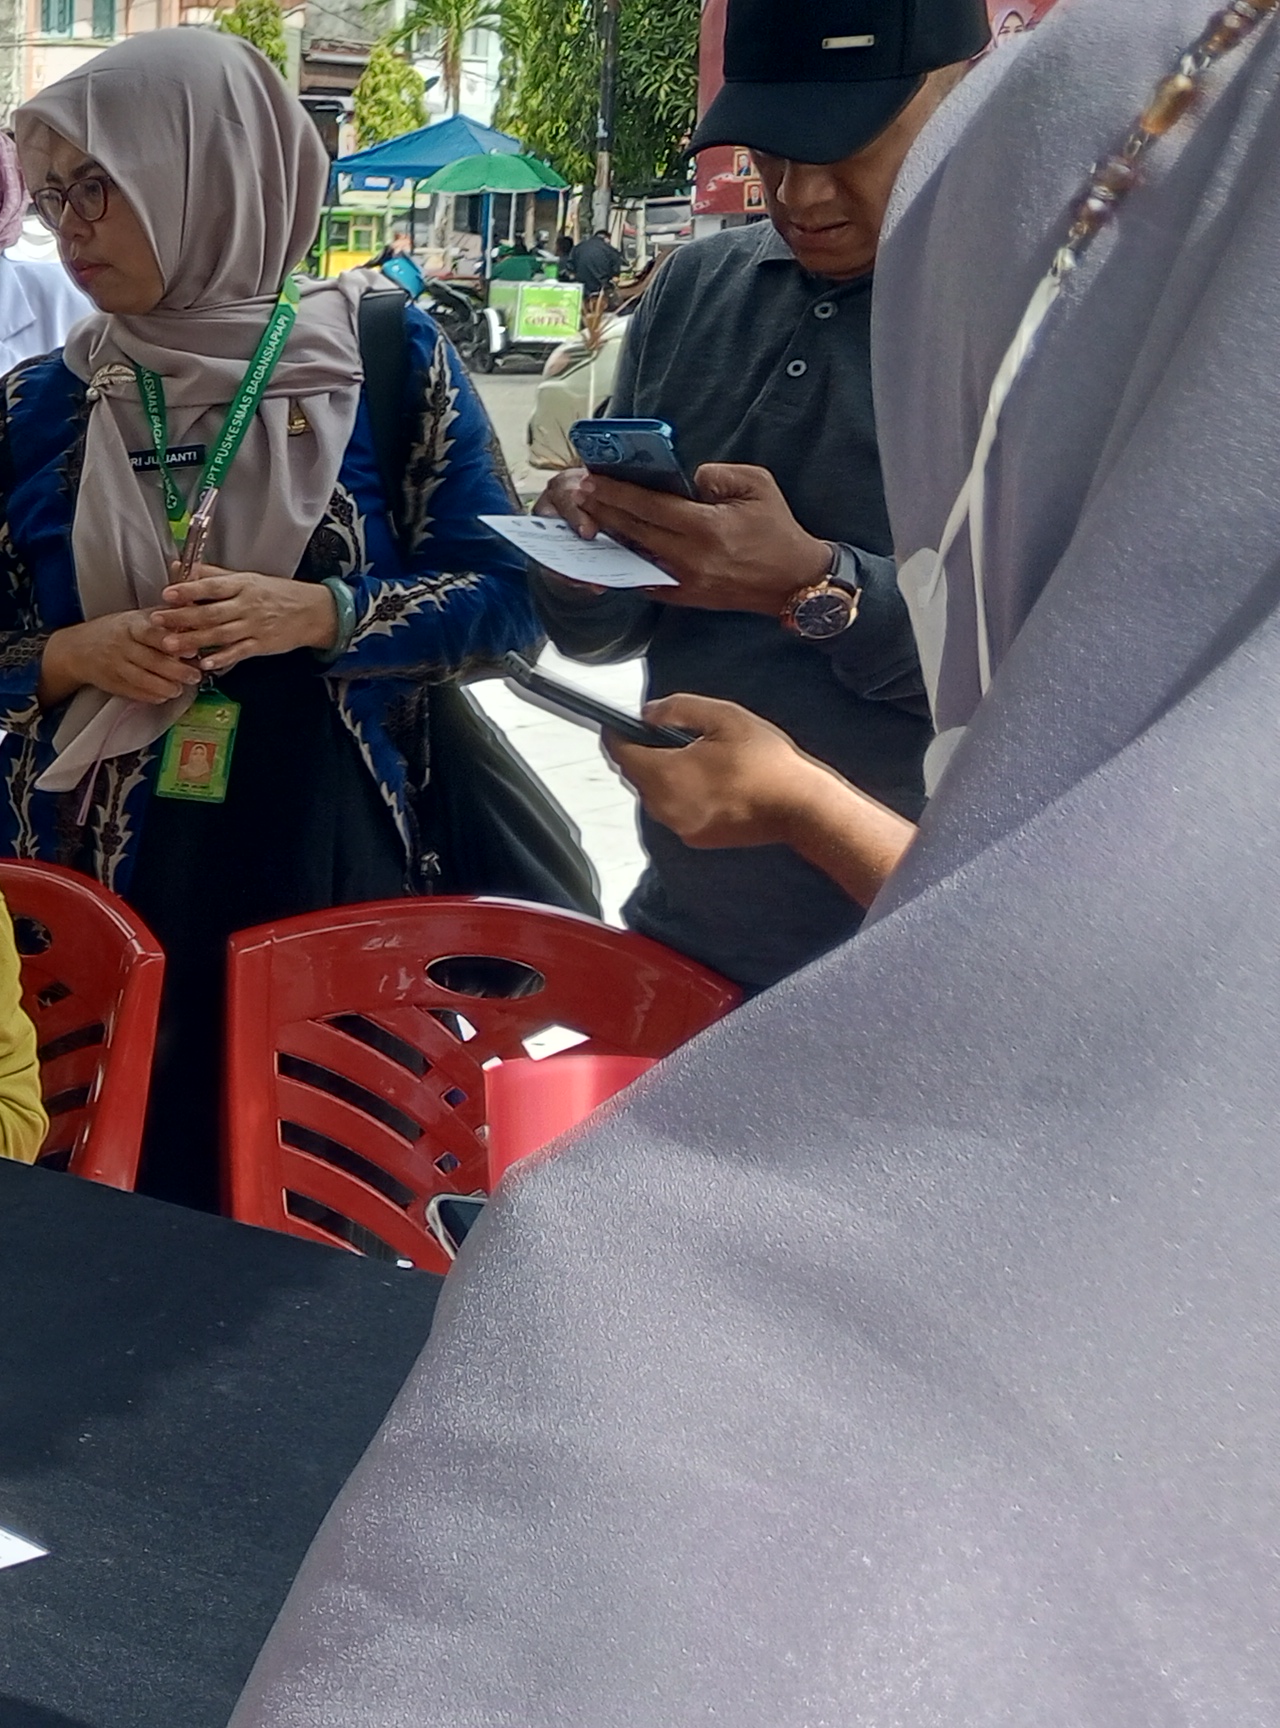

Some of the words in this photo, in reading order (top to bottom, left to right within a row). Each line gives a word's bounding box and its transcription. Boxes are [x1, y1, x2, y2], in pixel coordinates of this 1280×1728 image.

[203, 465, 221, 489] UPT
[214, 395, 252, 465] PUSKESMAS
[246, 314, 290, 396] BAGANSIAPIAPI
[144, 451, 197, 466] JUIANTI
